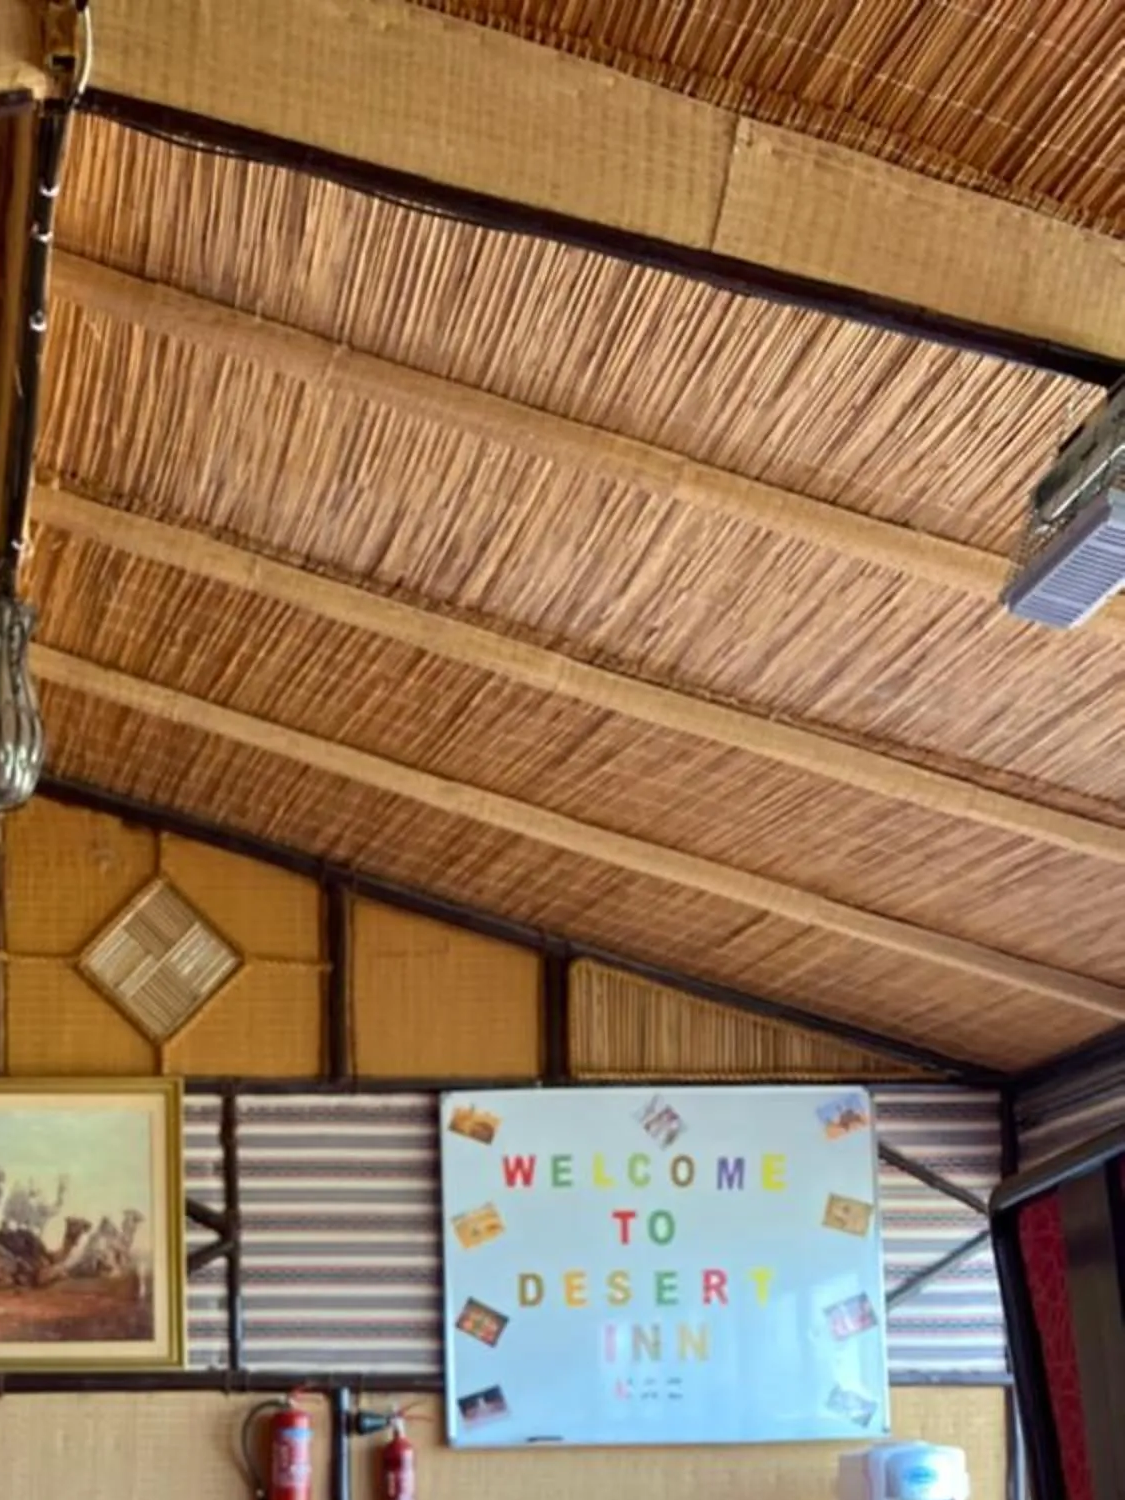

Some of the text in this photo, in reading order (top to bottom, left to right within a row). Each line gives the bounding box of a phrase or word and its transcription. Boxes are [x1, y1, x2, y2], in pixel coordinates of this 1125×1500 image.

[503, 1153, 787, 1191] WELCOME
[612, 1210, 676, 1246] TO
[517, 1268, 772, 1308] DESERT
[604, 1324, 709, 1362] INN
